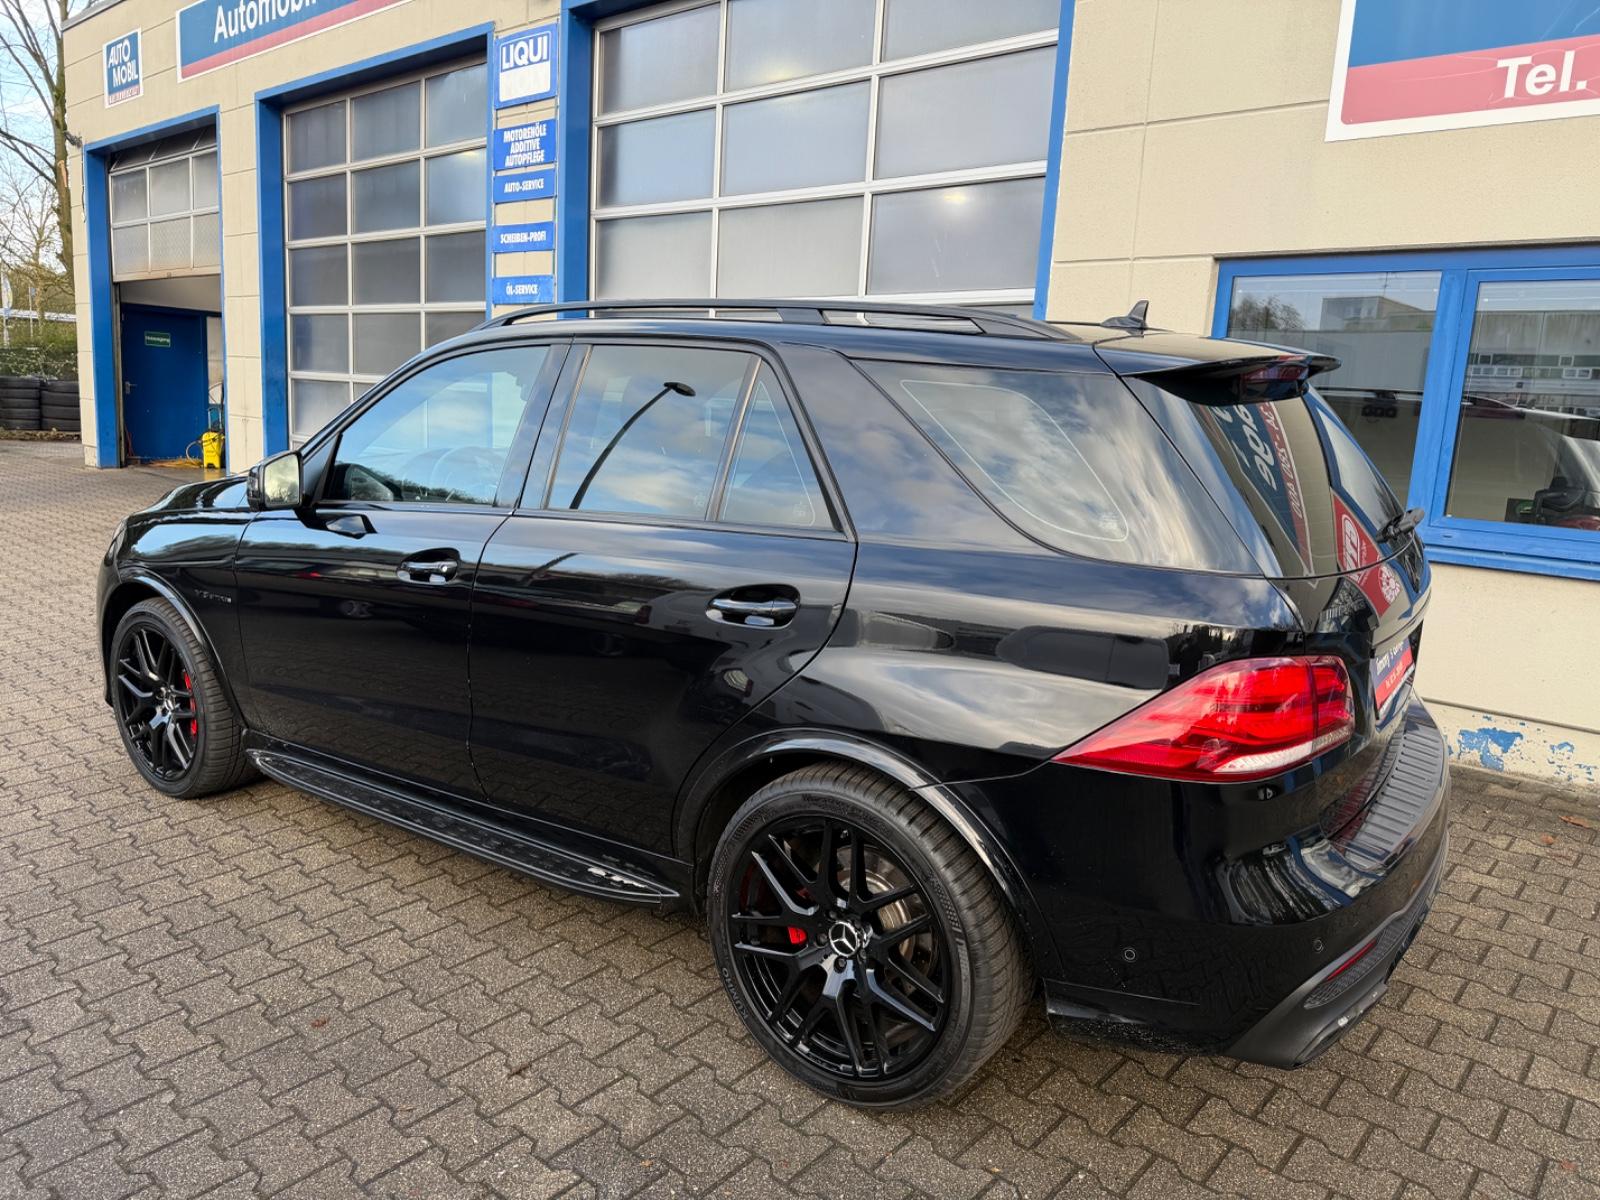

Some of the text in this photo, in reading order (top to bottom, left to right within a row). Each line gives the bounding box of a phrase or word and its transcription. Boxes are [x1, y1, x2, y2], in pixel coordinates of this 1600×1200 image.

[213, 0, 317, 44] Automob
[108, 38, 130, 68] AUTO
[502, 36, 548, 70] LIQUI
[112, 59, 138, 88] MOBIL
[1497, 50, 1588, 99] Tel.
[503, 122, 547, 142] MOTORENÖLE
[510, 138, 541, 154] ADDITIVE
[505, 150, 545, 167] AUTOPFLEGE
[504, 178, 545, 193] AUTO-SERVICE
[500, 231, 546, 244] SCHEIBEN-PROFI
[505, 282, 538, 296] ÖL-SERVICE
